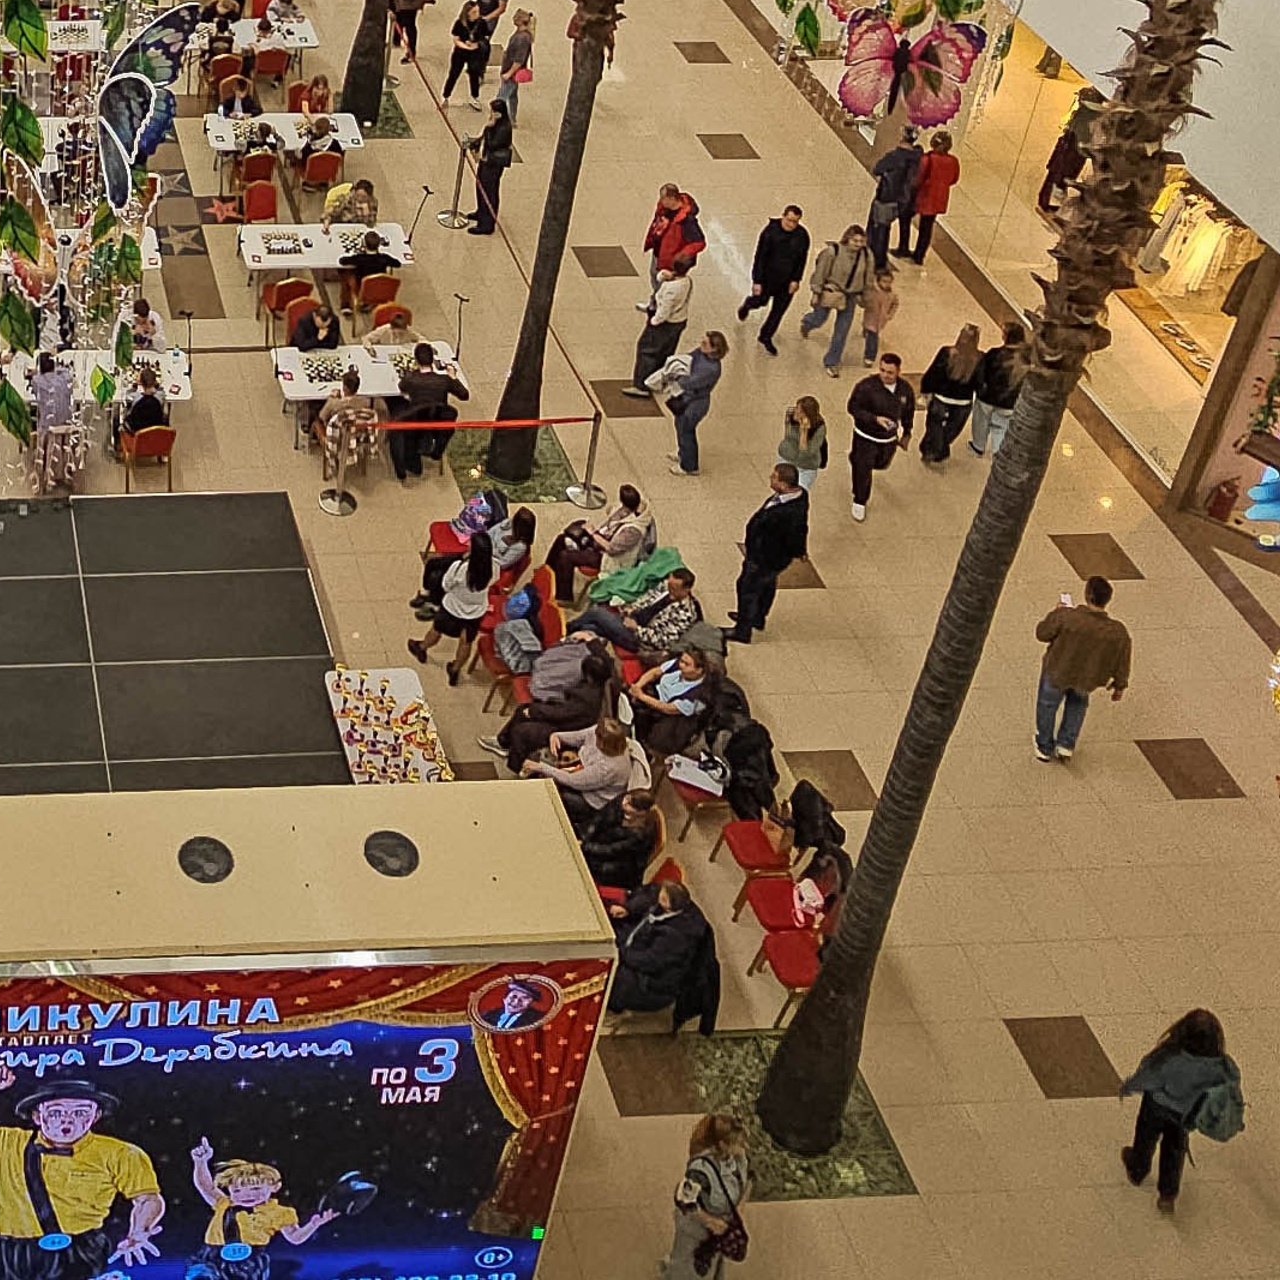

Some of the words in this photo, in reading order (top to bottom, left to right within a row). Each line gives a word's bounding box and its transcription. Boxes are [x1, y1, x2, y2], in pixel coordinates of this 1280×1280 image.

[93, 1029, 353, 1073] Дерябкина
[370, 1067, 407, 1085] ПО
[414, 1038, 459, 1083] 3
[380, 1086, 441, 1104] МАЯ
